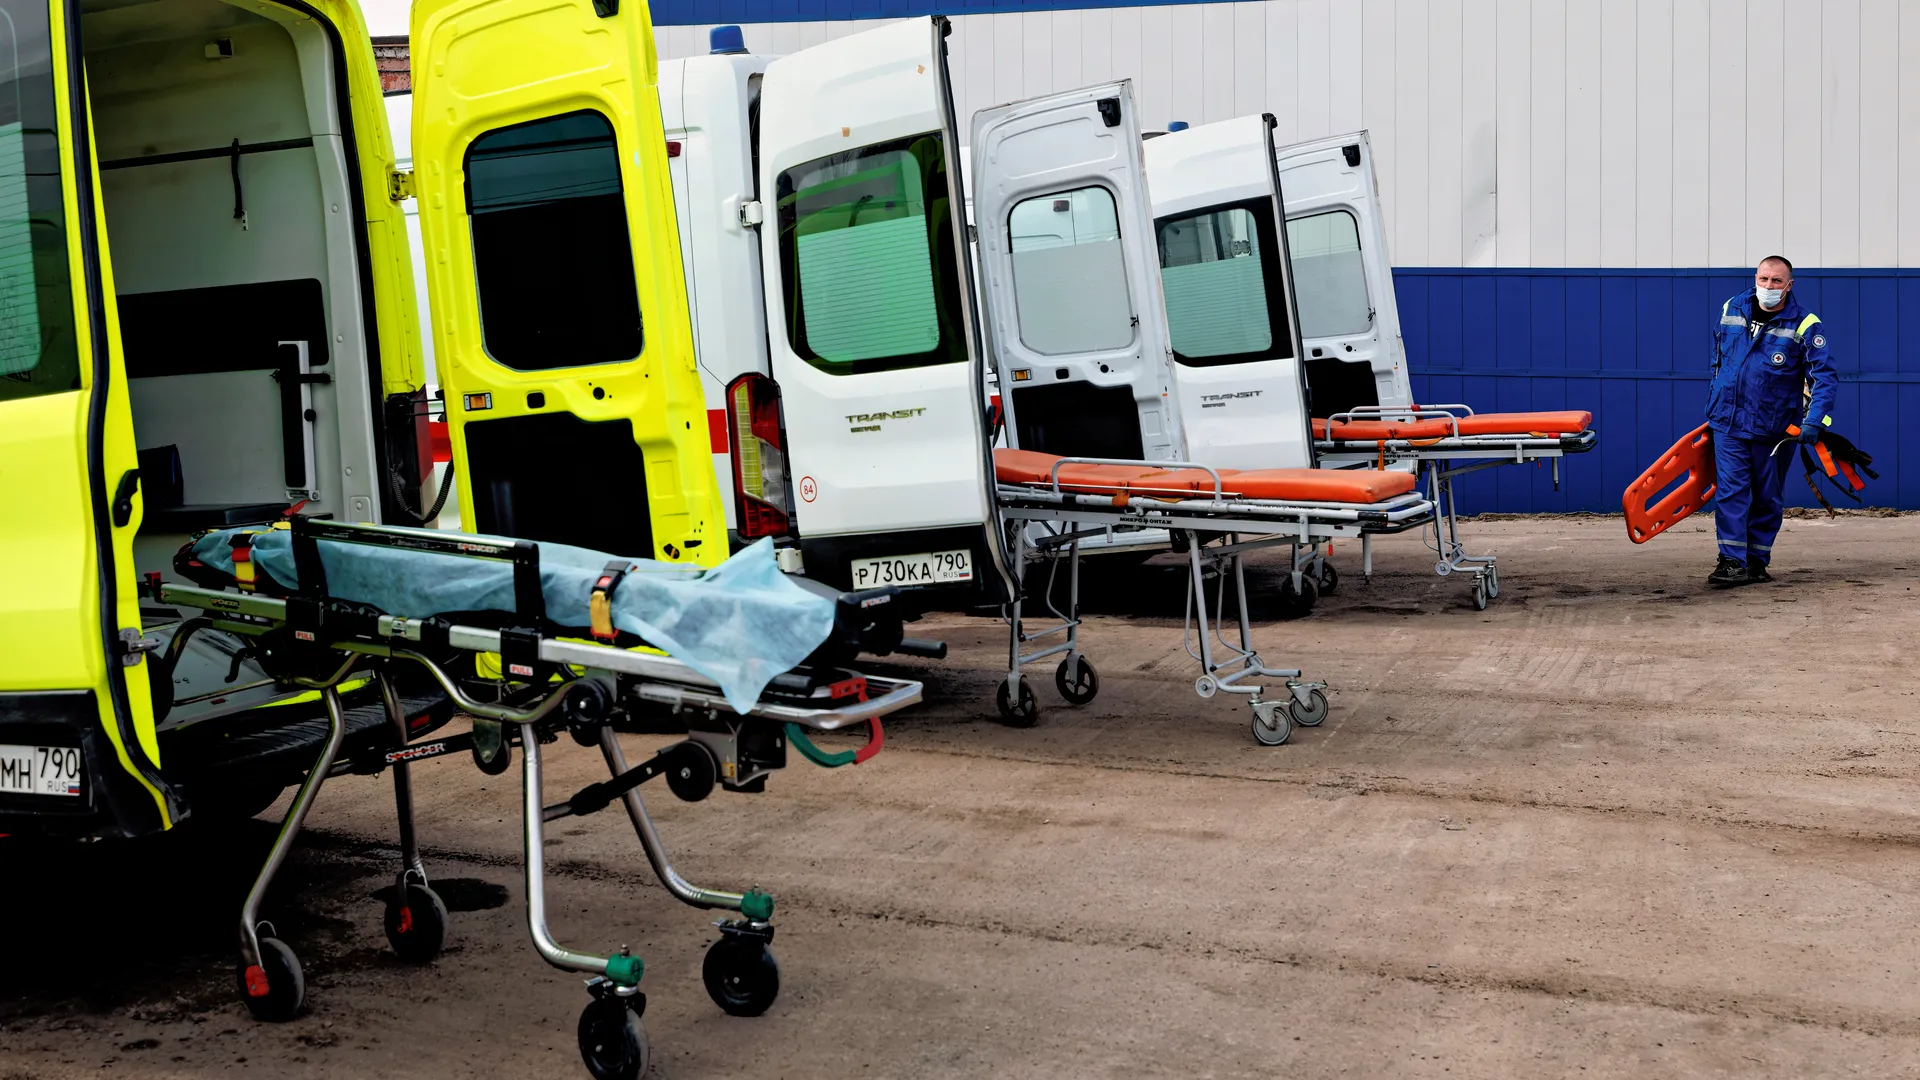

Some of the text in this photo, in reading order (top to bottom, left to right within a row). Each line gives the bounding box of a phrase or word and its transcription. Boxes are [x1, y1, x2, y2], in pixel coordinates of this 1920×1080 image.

[1200, 390, 1263, 401] TRANSIT
[845, 407, 926, 423] TRANSIT
[803, 484, 813, 495] 84
[858, 553, 965, 585] Р730КА 790
[943, 571, 959, 579] RUS
[297, 631, 314, 640] PULL
[511, 665, 531, 675] PULL
[385, 743, 446, 763] SPENCER
[38, 747, 77, 779] 790
[47, 780, 67, 793] RUS
